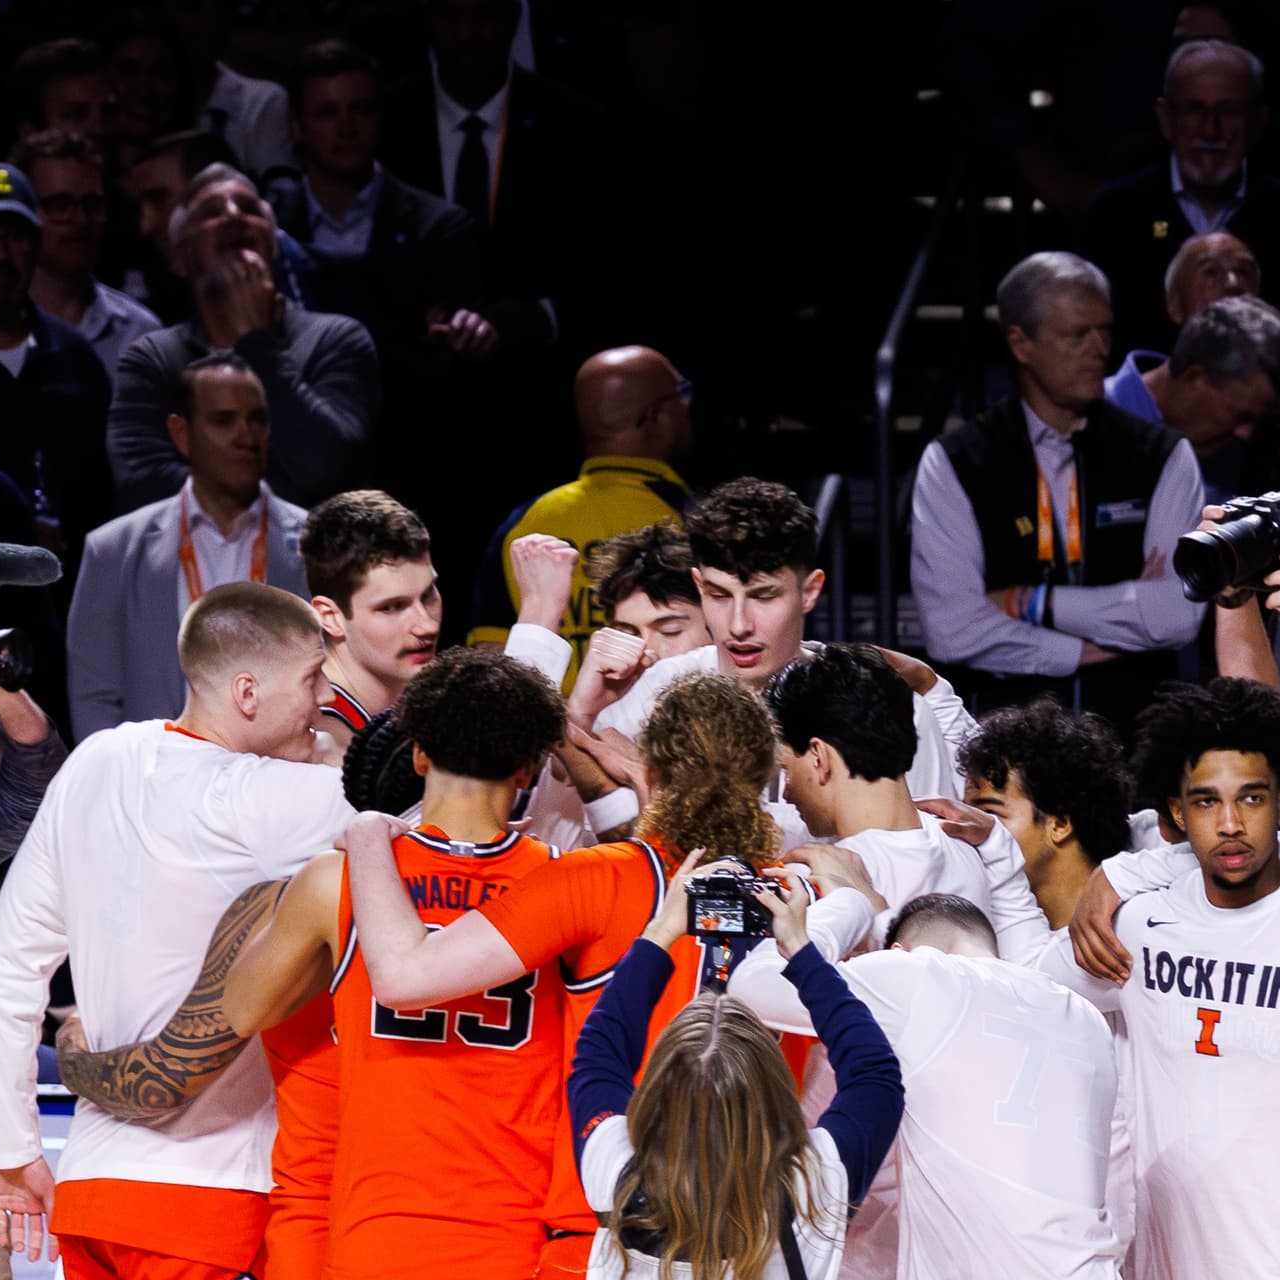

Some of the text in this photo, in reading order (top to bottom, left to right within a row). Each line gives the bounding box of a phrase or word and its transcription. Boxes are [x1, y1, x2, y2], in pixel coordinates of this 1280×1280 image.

[404, 875, 510, 909] WAGLE
[1143, 946, 1217, 1000] LOCK
[1221, 961, 1255, 1005] IT
[1195, 1007, 1222, 1058] I
